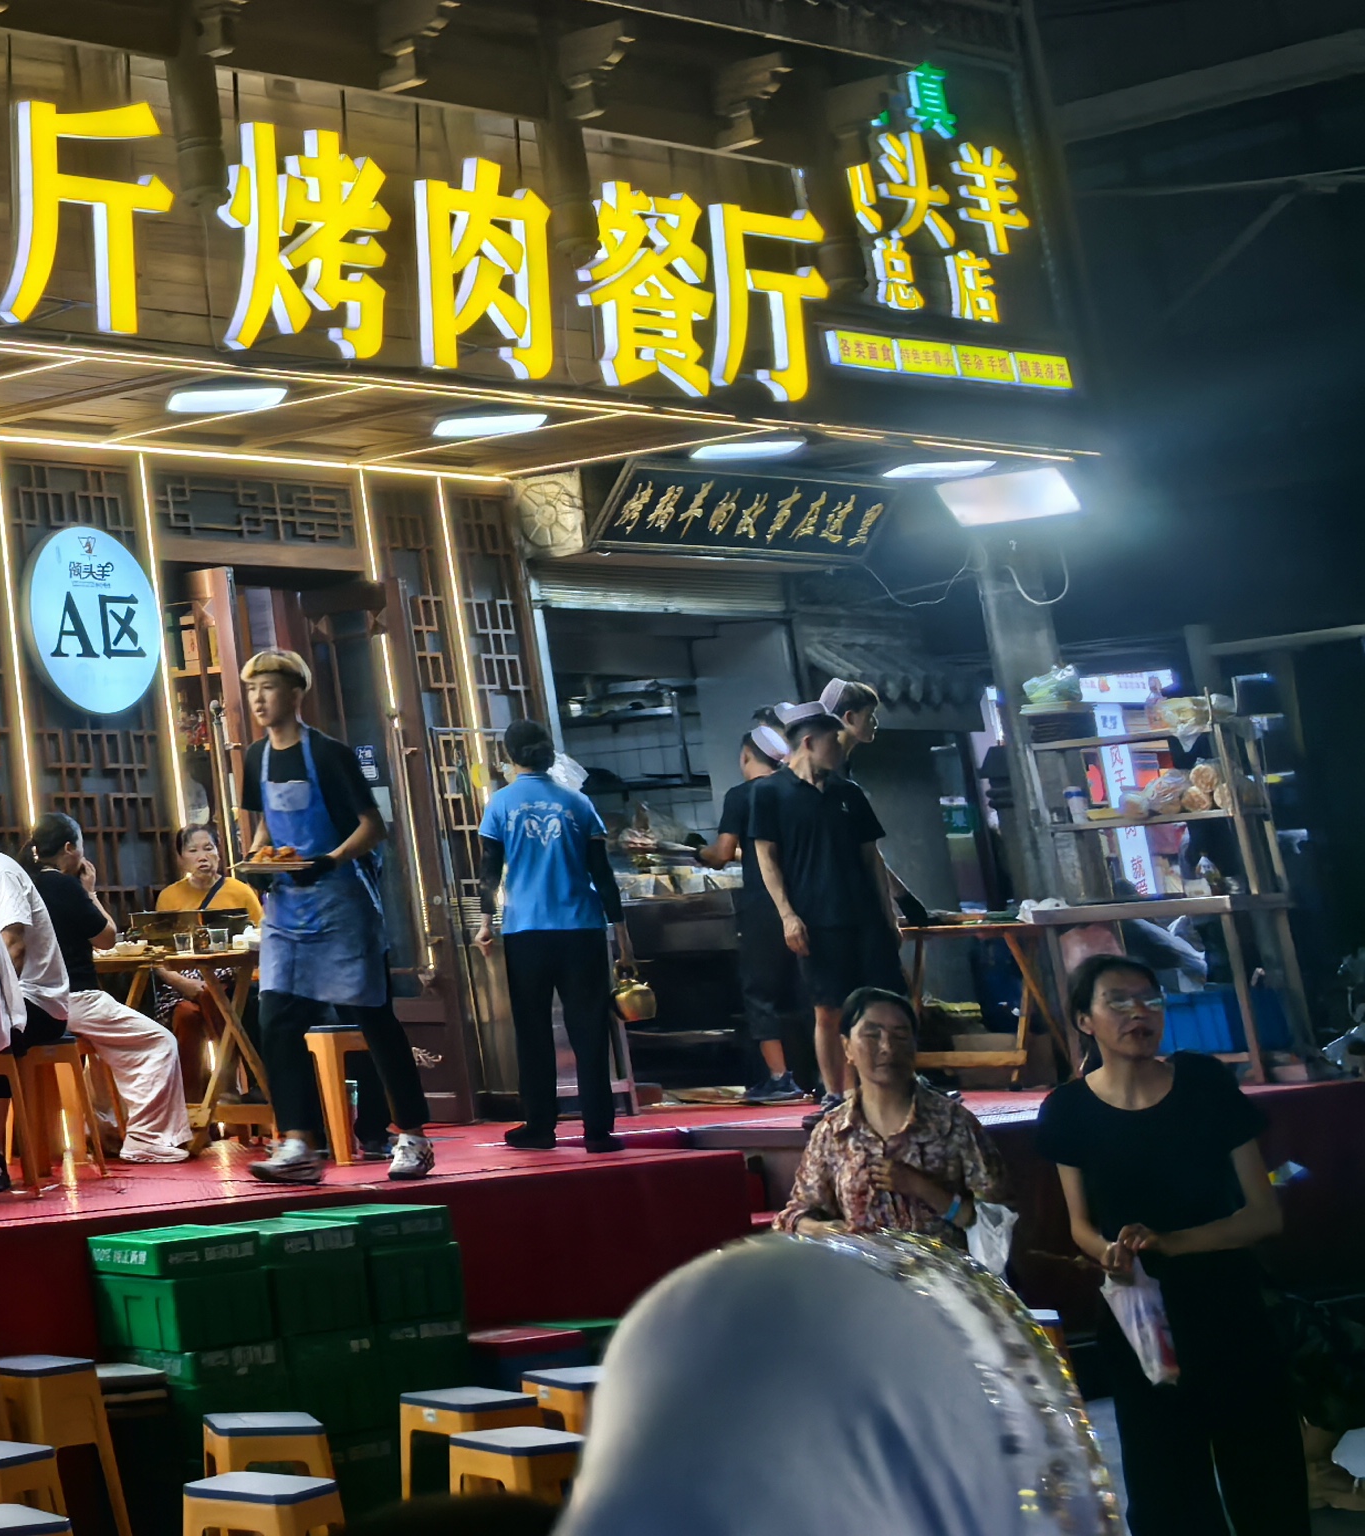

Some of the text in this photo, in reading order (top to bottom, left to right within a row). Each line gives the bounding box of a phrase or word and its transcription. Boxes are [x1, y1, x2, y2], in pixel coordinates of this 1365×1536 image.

[871, 61, 958, 139] 真
[871, 236, 1001, 323] 总店
[50, 591, 147, 659] A区
